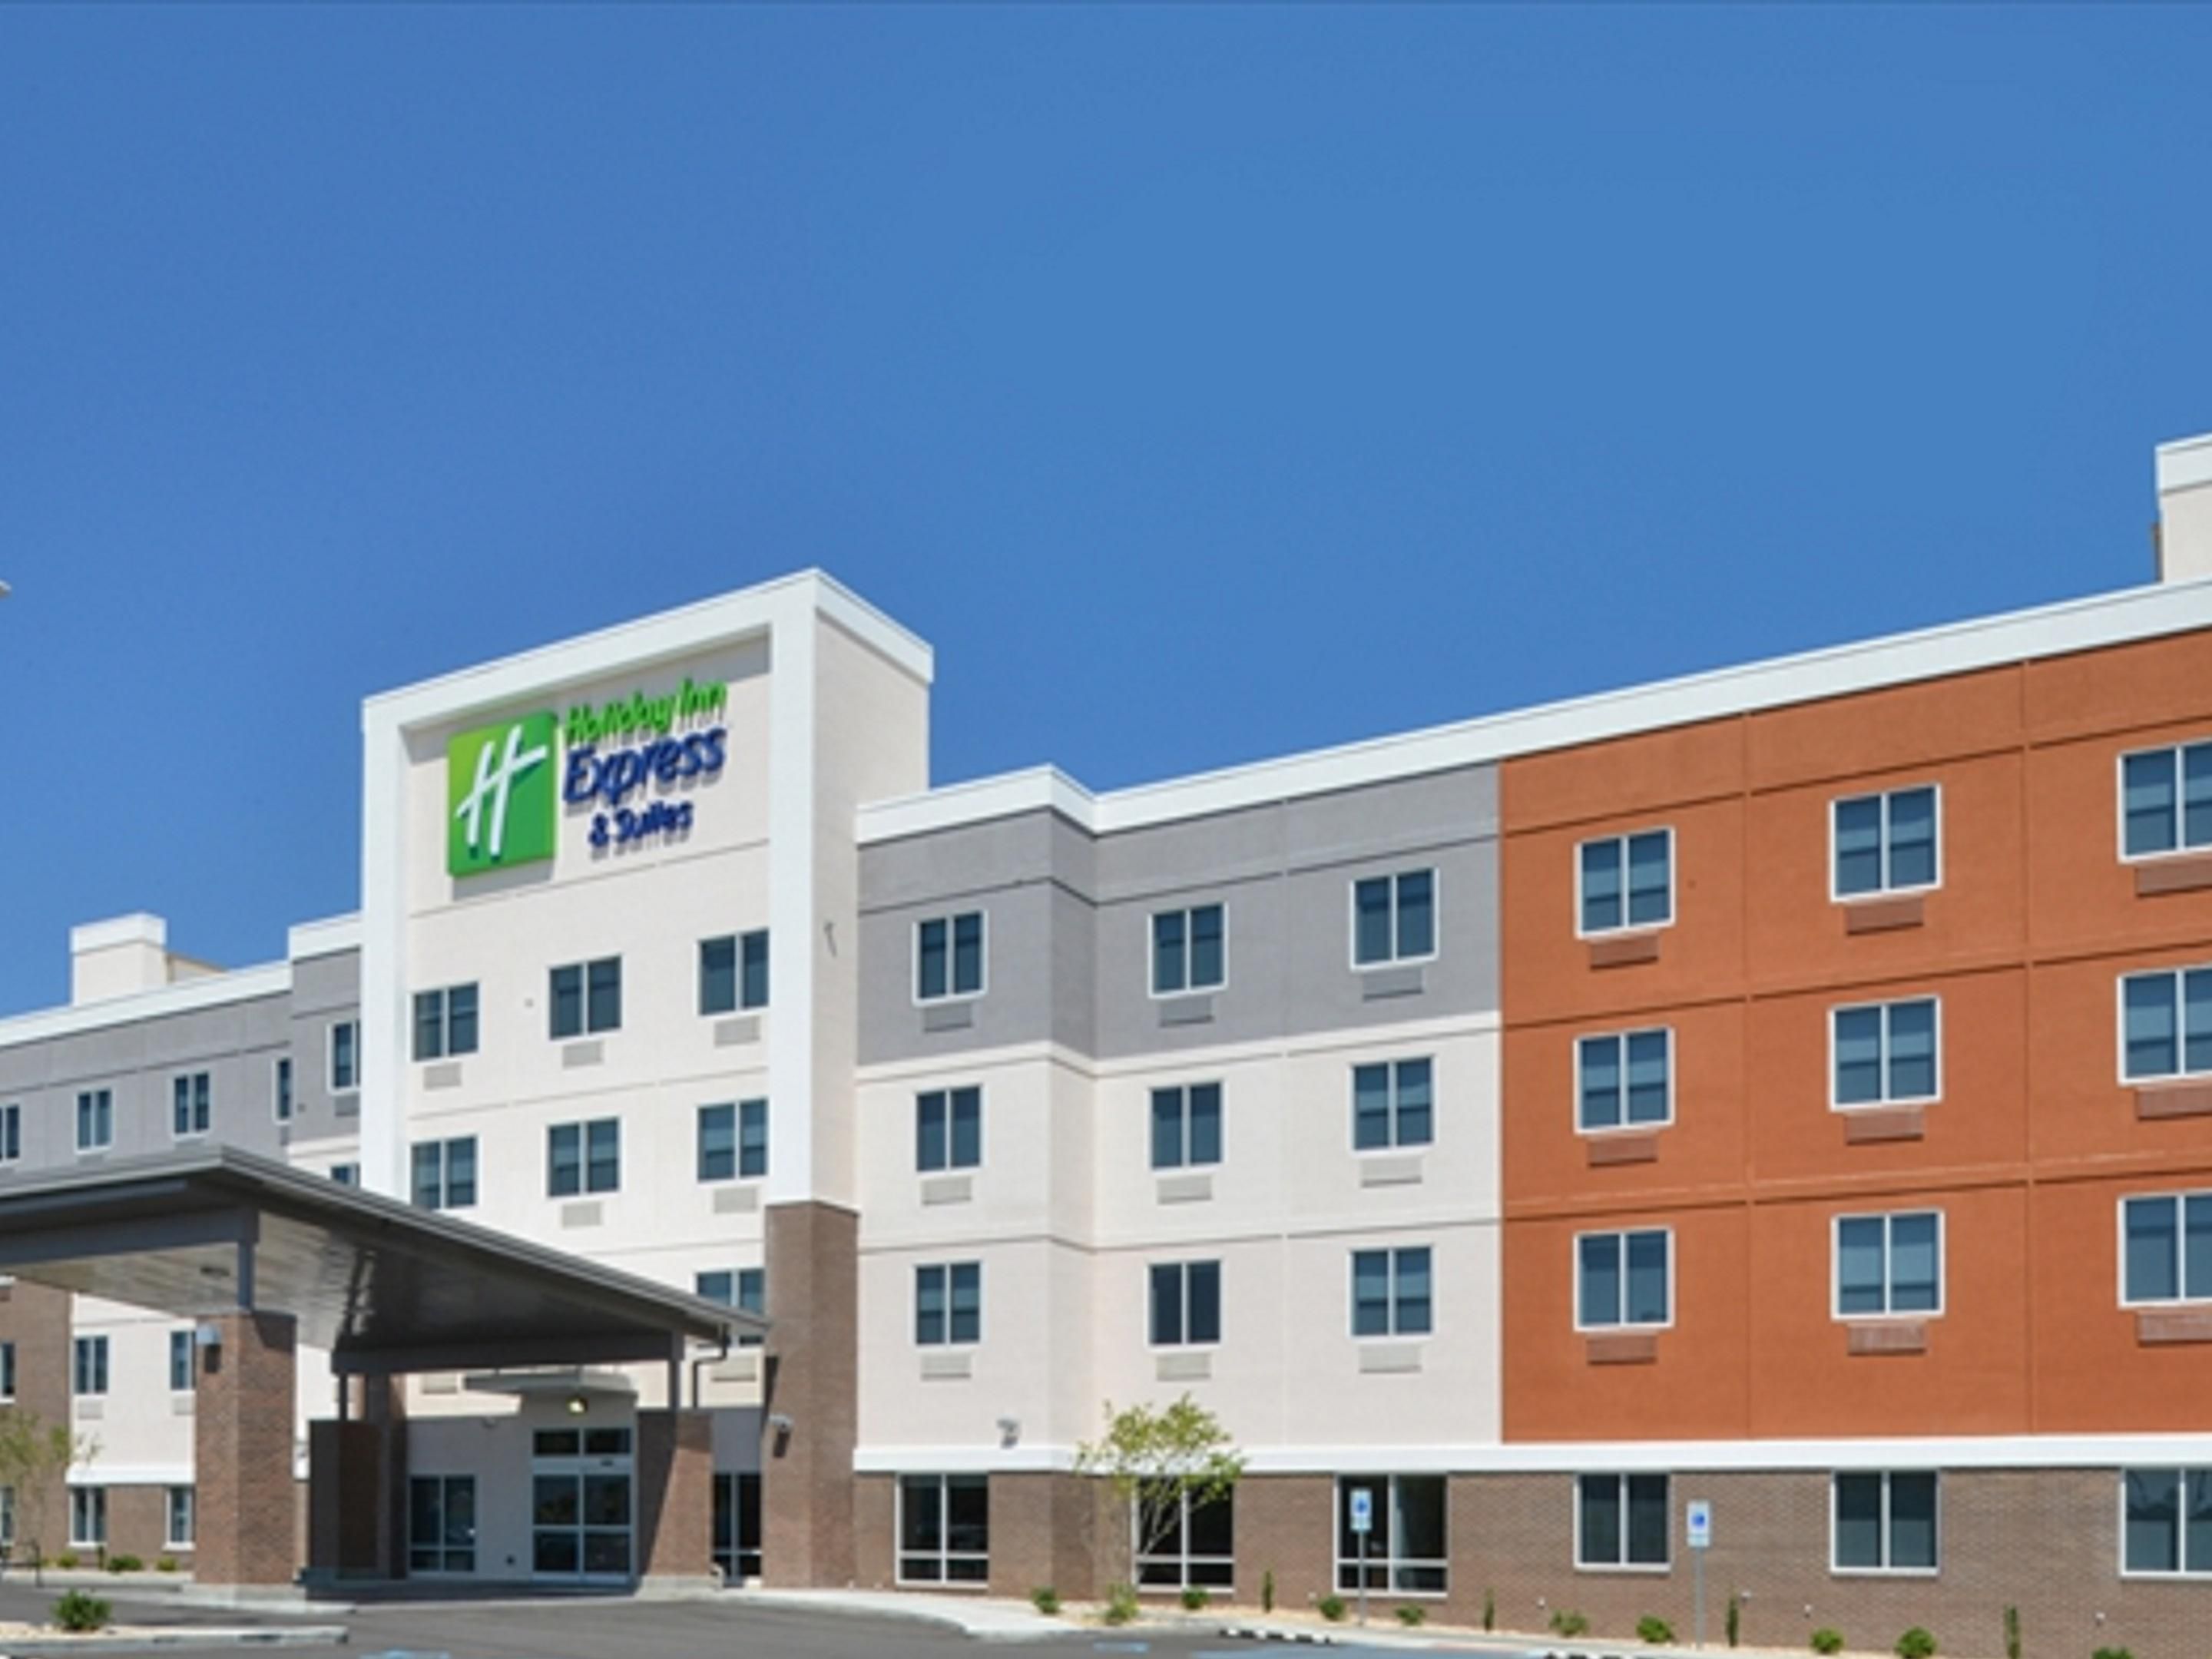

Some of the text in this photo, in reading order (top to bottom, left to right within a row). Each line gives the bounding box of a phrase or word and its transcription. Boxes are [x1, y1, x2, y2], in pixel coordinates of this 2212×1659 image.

[567, 678, 727, 743] Holiday Inn
[562, 727, 727, 805] Express
[588, 800, 694, 848] & Suites
